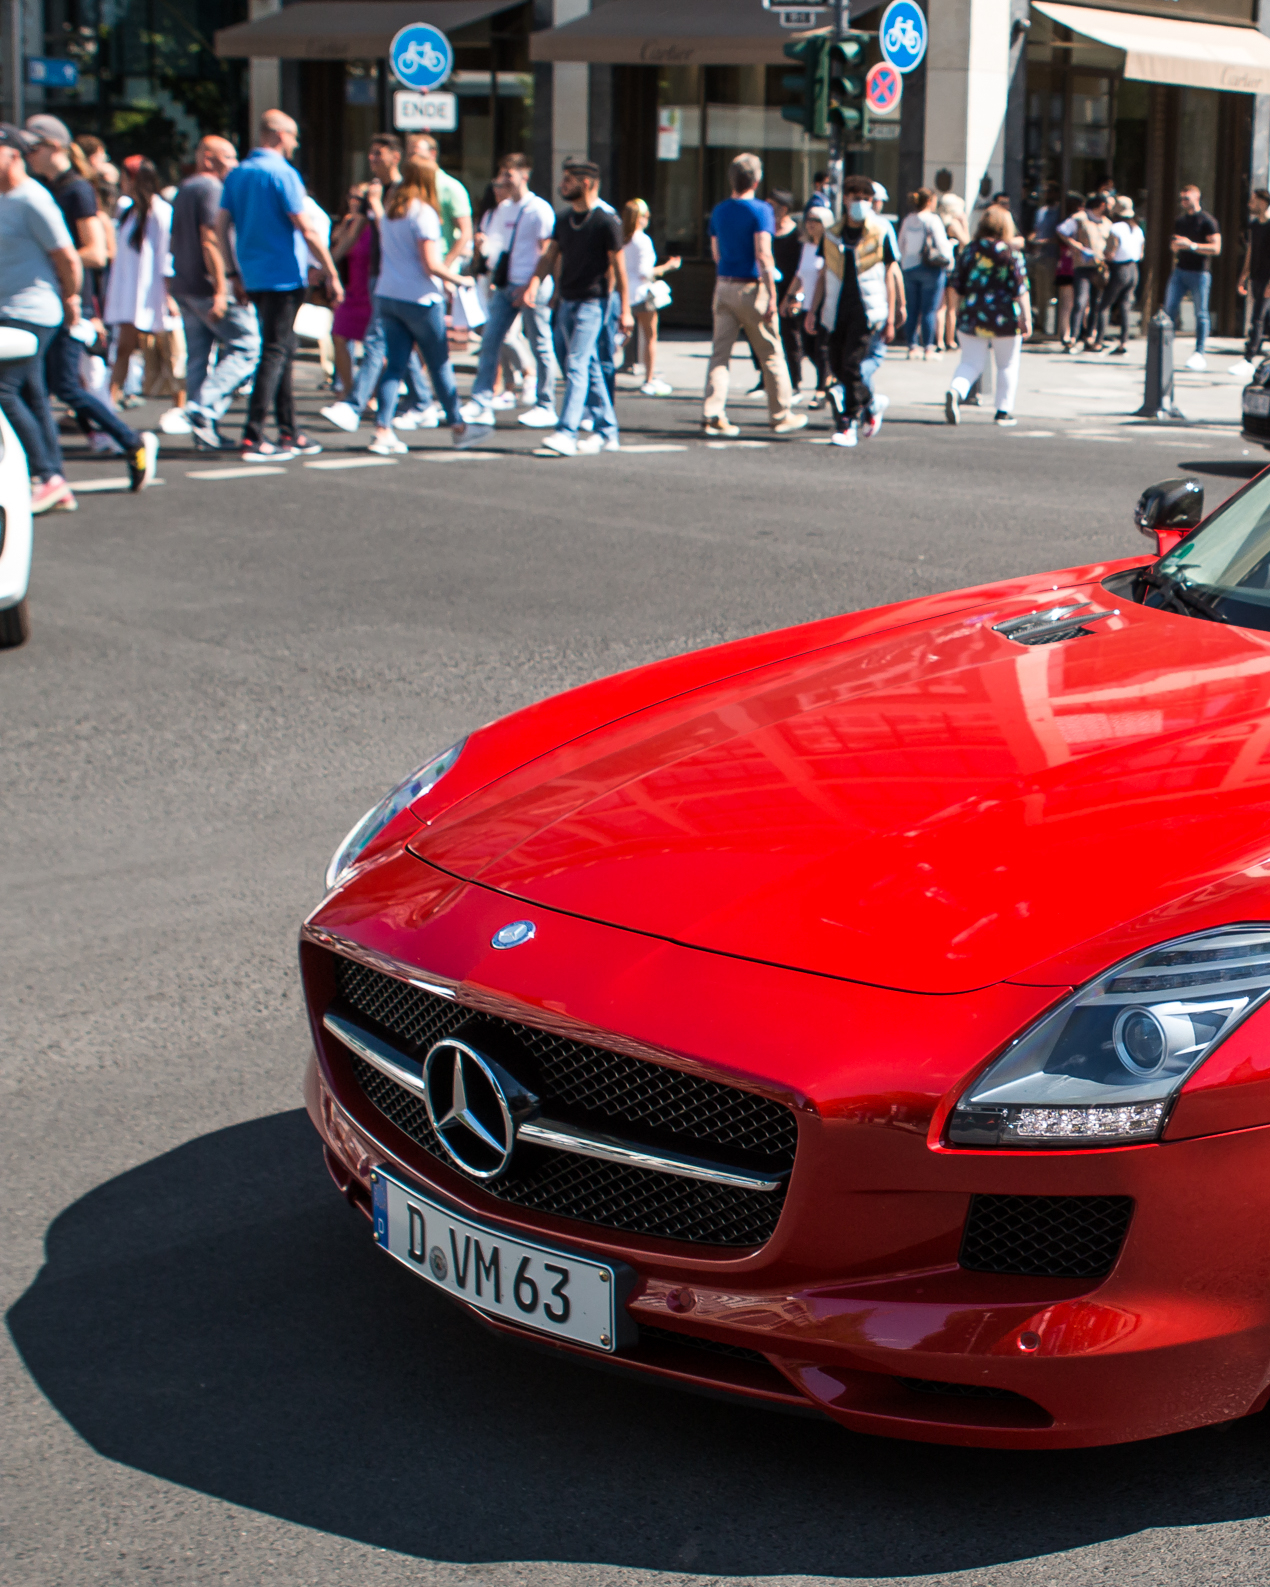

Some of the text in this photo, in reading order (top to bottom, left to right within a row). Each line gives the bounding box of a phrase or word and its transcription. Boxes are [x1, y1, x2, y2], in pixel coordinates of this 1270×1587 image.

[1220, 66, 1263, 88] Cartier
[402, 100, 448, 118] ENDE
[377, 1217, 384, 1235] D
[407, 1200, 570, 1324] D VM 63
